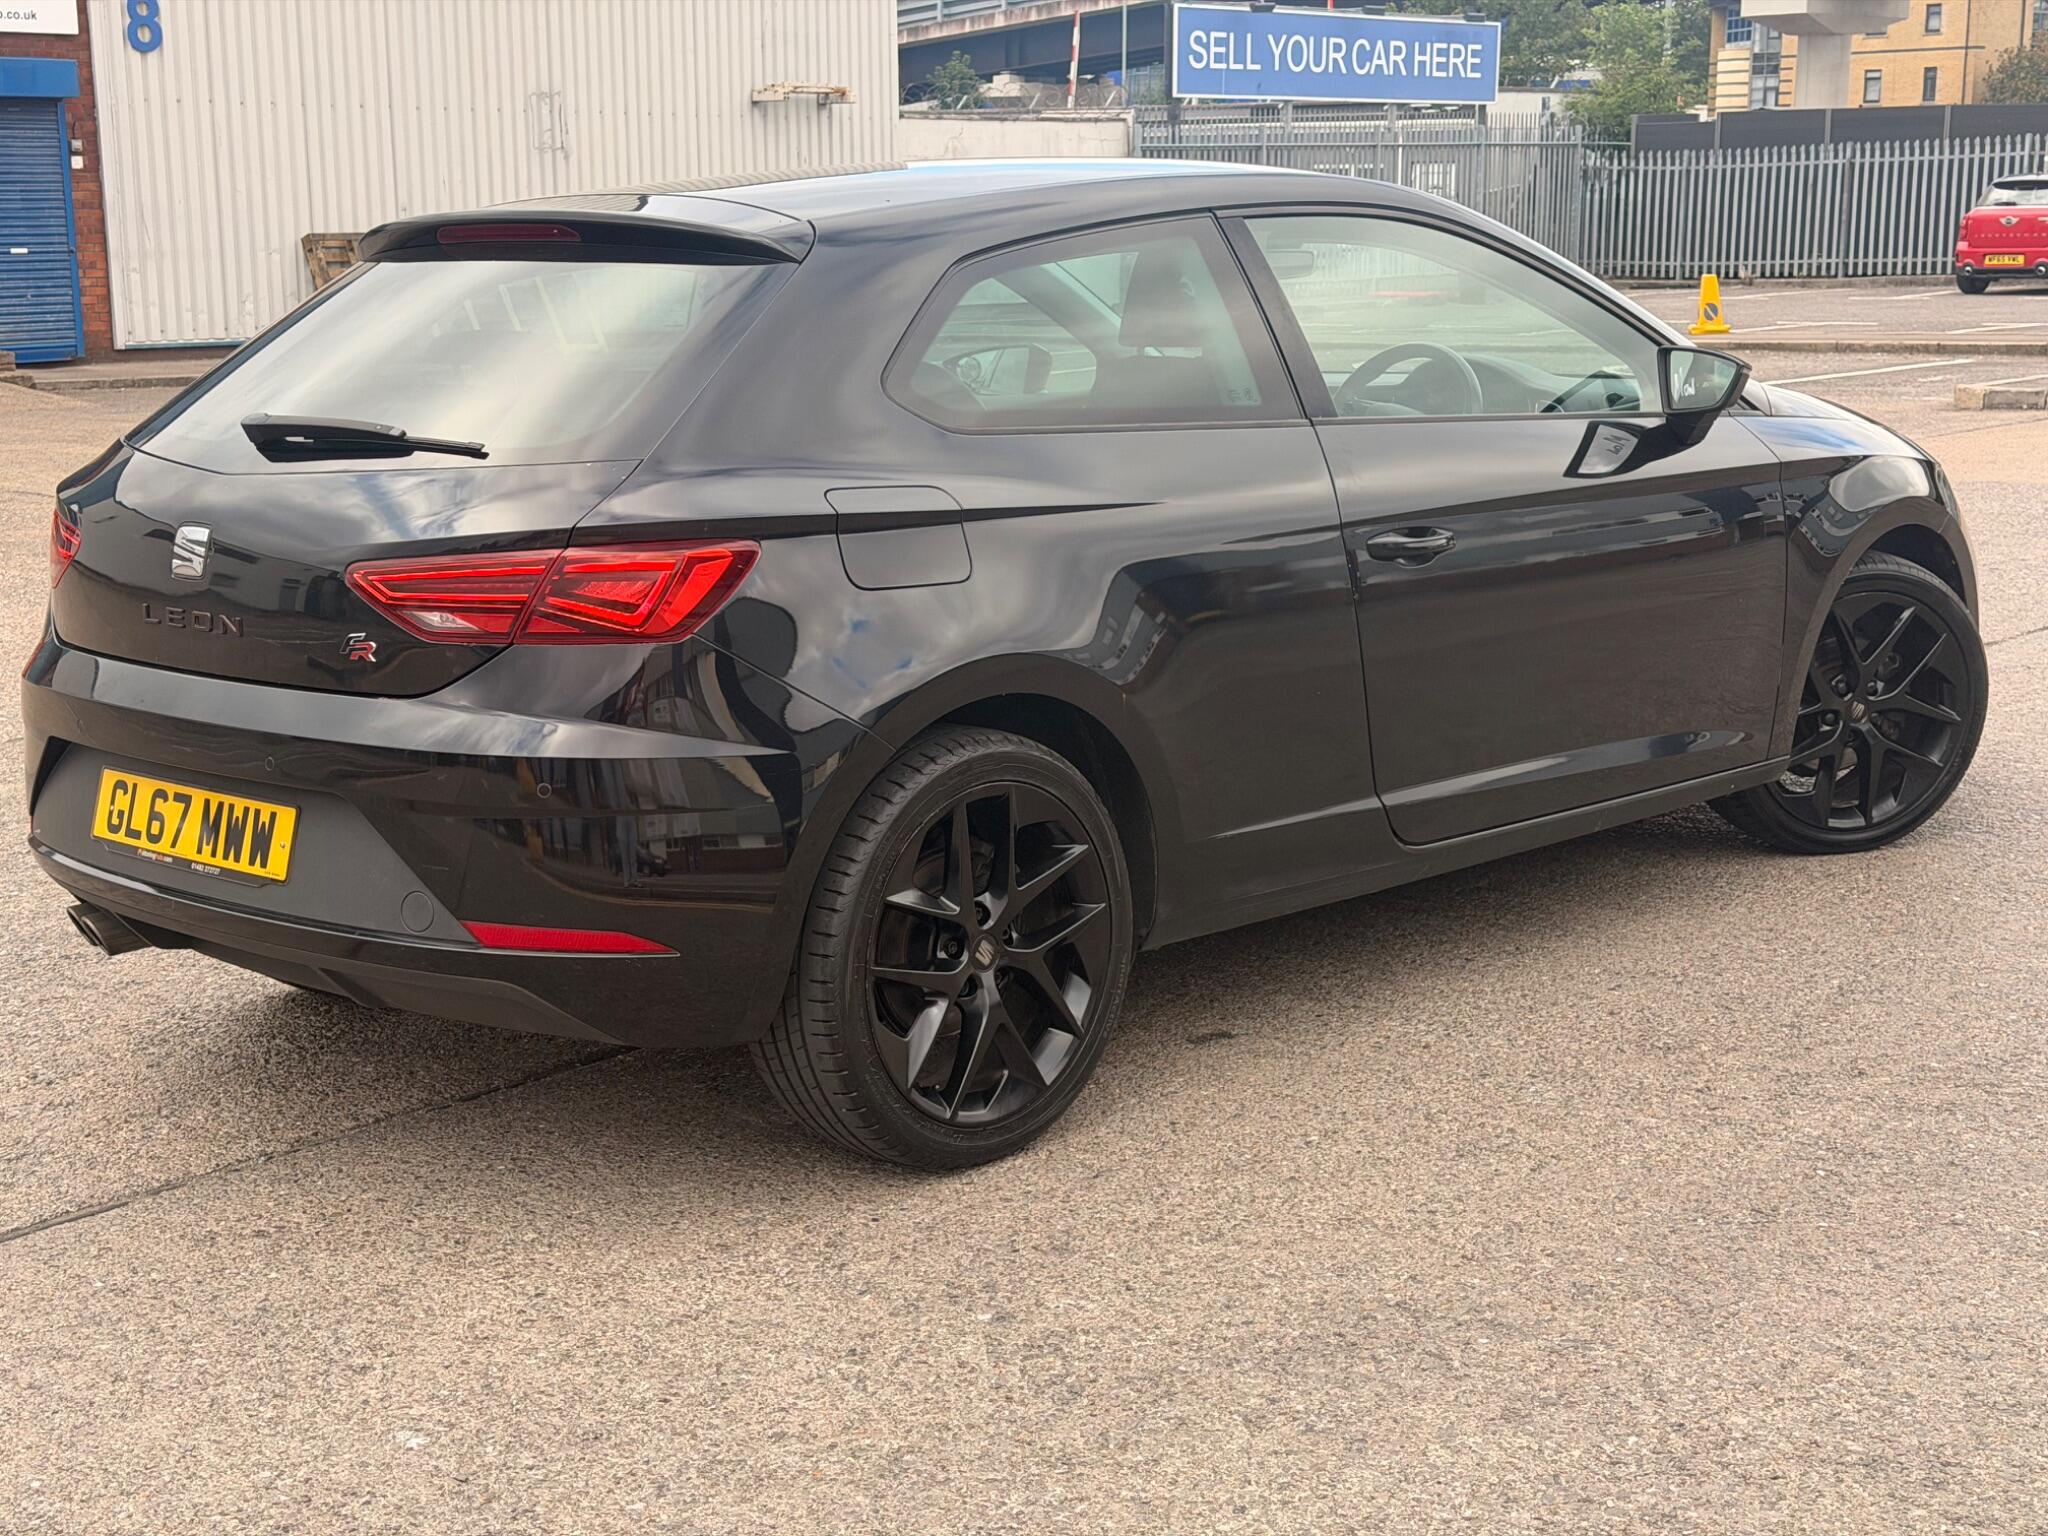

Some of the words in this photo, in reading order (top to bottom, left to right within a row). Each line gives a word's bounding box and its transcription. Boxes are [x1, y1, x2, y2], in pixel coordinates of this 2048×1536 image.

[127, 0, 163, 53] 8
[1188, 30, 1262, 70] SELL
[1268, 34, 1347, 75] YOUR
[1352, 40, 1407, 77] CAR
[1414, 42, 1482, 79] HERE
[141, 602, 244, 637] LEON
[339, 632, 377, 662] FR
[106, 779, 193, 849] GL67
[196, 798, 277, 869] MWW
